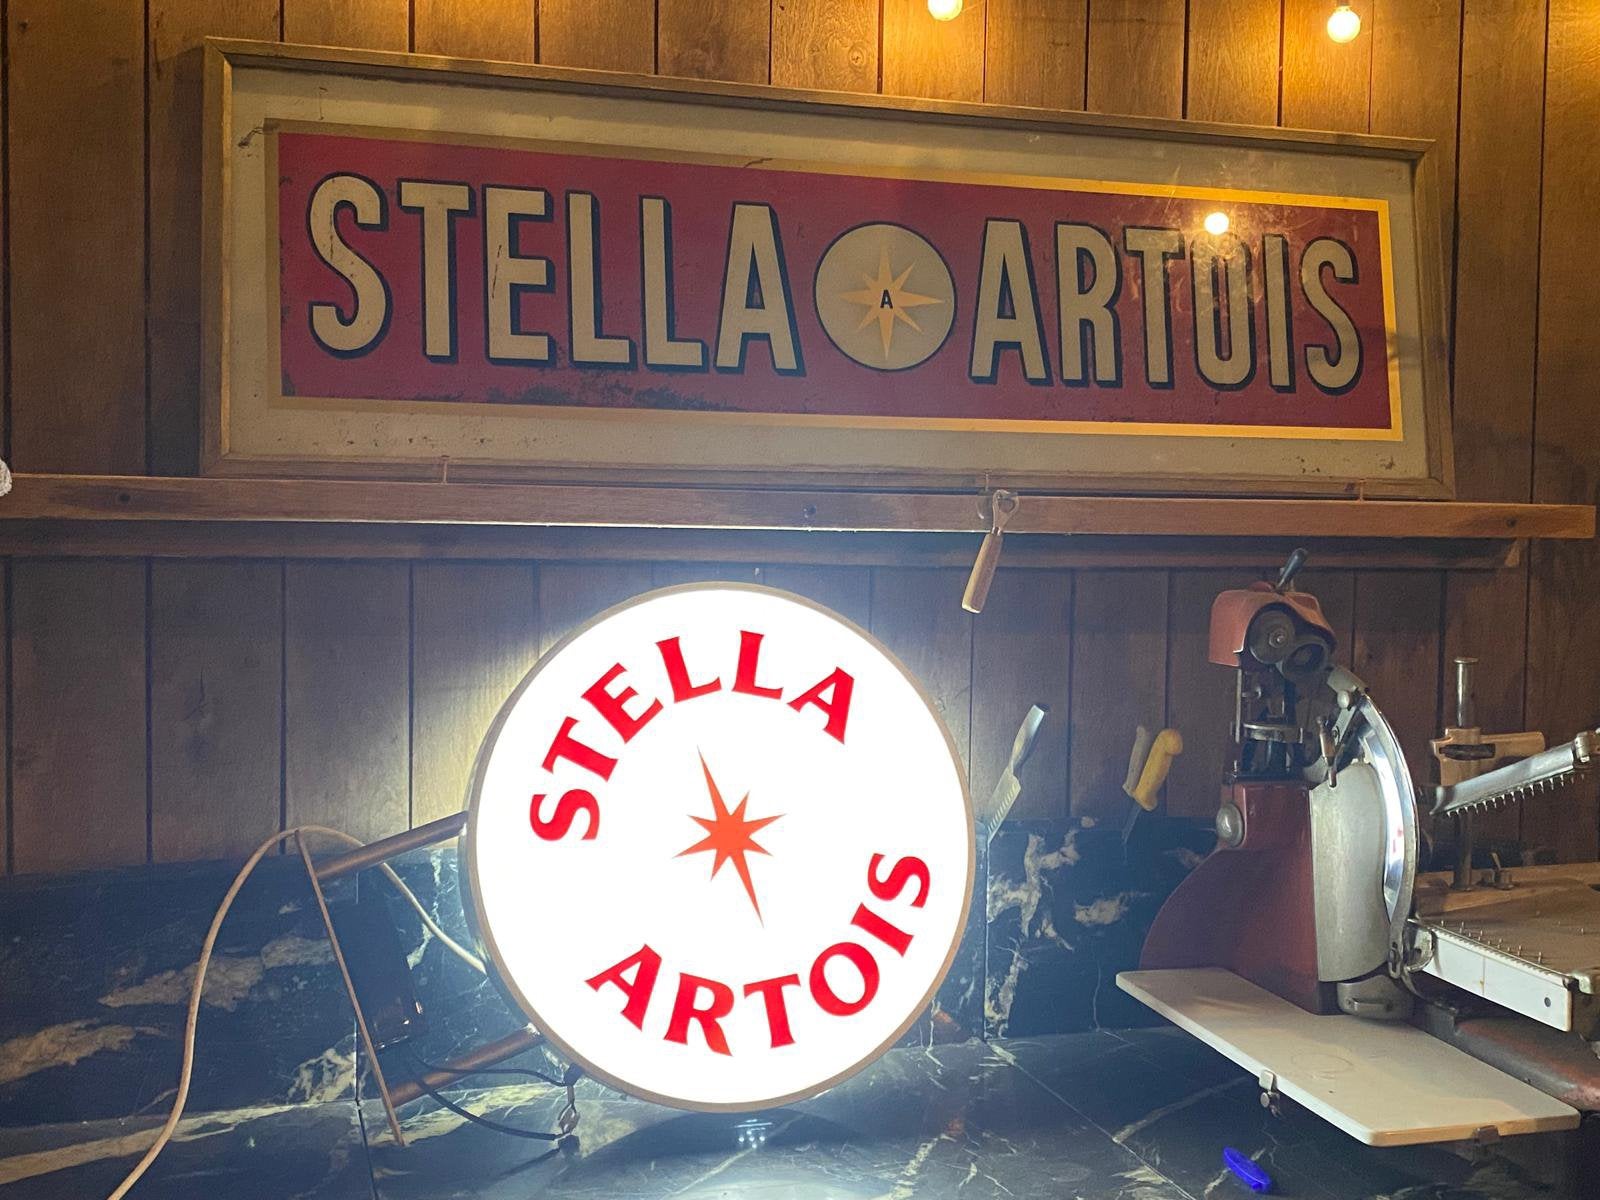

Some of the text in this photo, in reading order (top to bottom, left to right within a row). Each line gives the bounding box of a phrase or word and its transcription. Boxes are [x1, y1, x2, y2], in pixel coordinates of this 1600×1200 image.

[307, 172, 1363, 396] STELLA ARTOIS
[880, 289, 893, 309] A
[529, 630, 855, 841] STELLA
[585, 852, 931, 1057] ARTOIS
